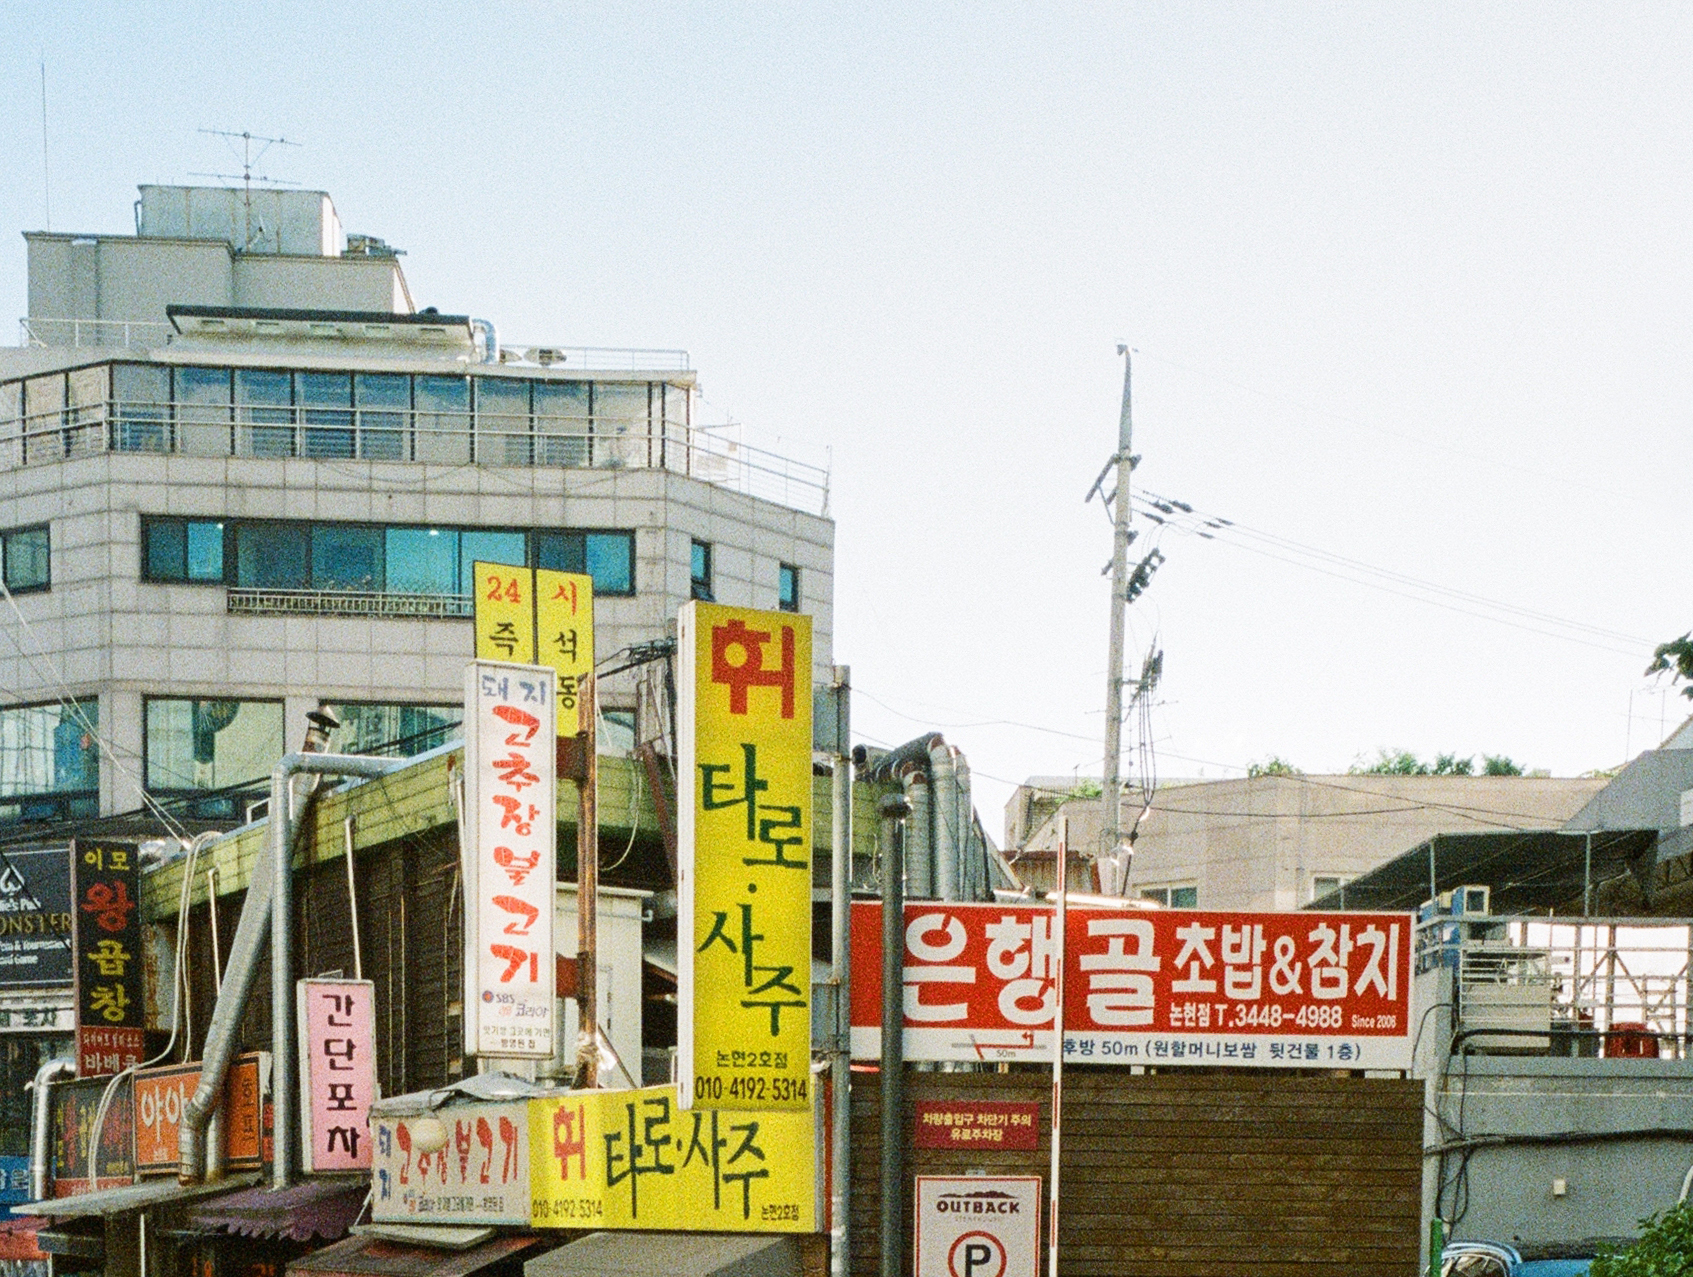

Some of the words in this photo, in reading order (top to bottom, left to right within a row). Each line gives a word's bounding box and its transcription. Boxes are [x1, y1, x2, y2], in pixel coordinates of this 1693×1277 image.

[482, 675, 547, 705] 돼지
[491, 705, 541, 984] 고추장불고기
[84, 848, 130, 871] 이모
[902, 913, 1161, 1026] 은행골
[1171, 921, 1400, 1001] 초밥&참치
[1169, 1003, 1210, 1028] 논현점
[1215, 1004, 1343, 1029] T.3448-4988
[1351, 1015, 1375, 1029] Since
[716, 1050, 788, 1069] 논현2호점
[996, 1050, 1016, 1058] 50m
[1102, 1041, 1138, 1055] 50m
[322, 993, 360, 1159] 간단포차
[695, 1076, 808, 1101] 010-4192-5314
[1010, 1114, 1032, 1127] 주의
[760, 1205, 800, 1221] 논현2호점
[936, 1200, 1020, 1214] OUTBACK
